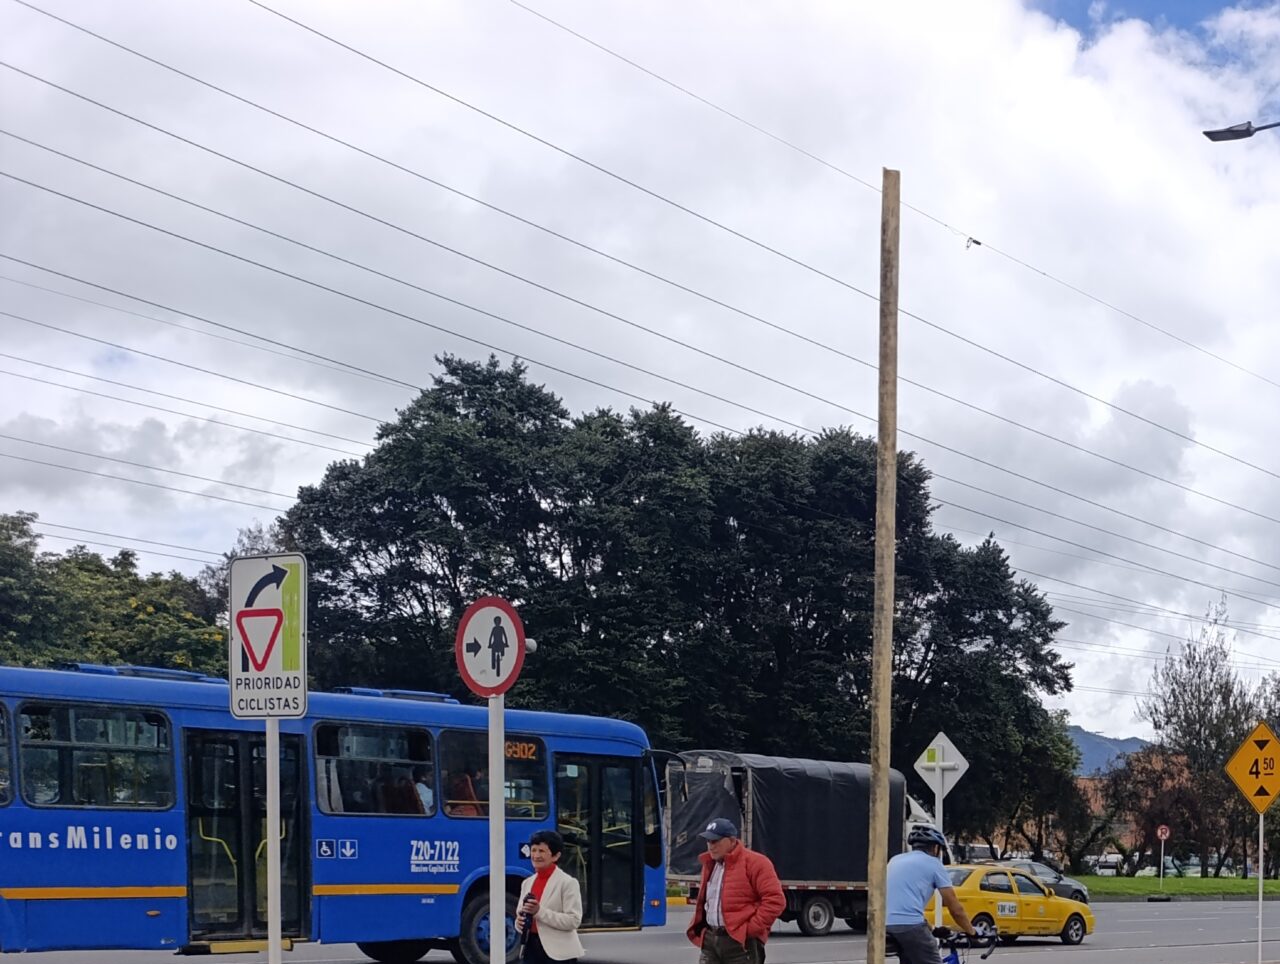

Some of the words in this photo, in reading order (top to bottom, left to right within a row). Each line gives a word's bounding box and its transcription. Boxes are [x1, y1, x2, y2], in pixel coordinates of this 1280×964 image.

[235, 676, 301, 691] PRIORIDAD
[237, 697, 300, 711] CICLISTAS
[0, 826, 178, 850] ansMilenio
[410, 840, 460, 861] Z20-7122
